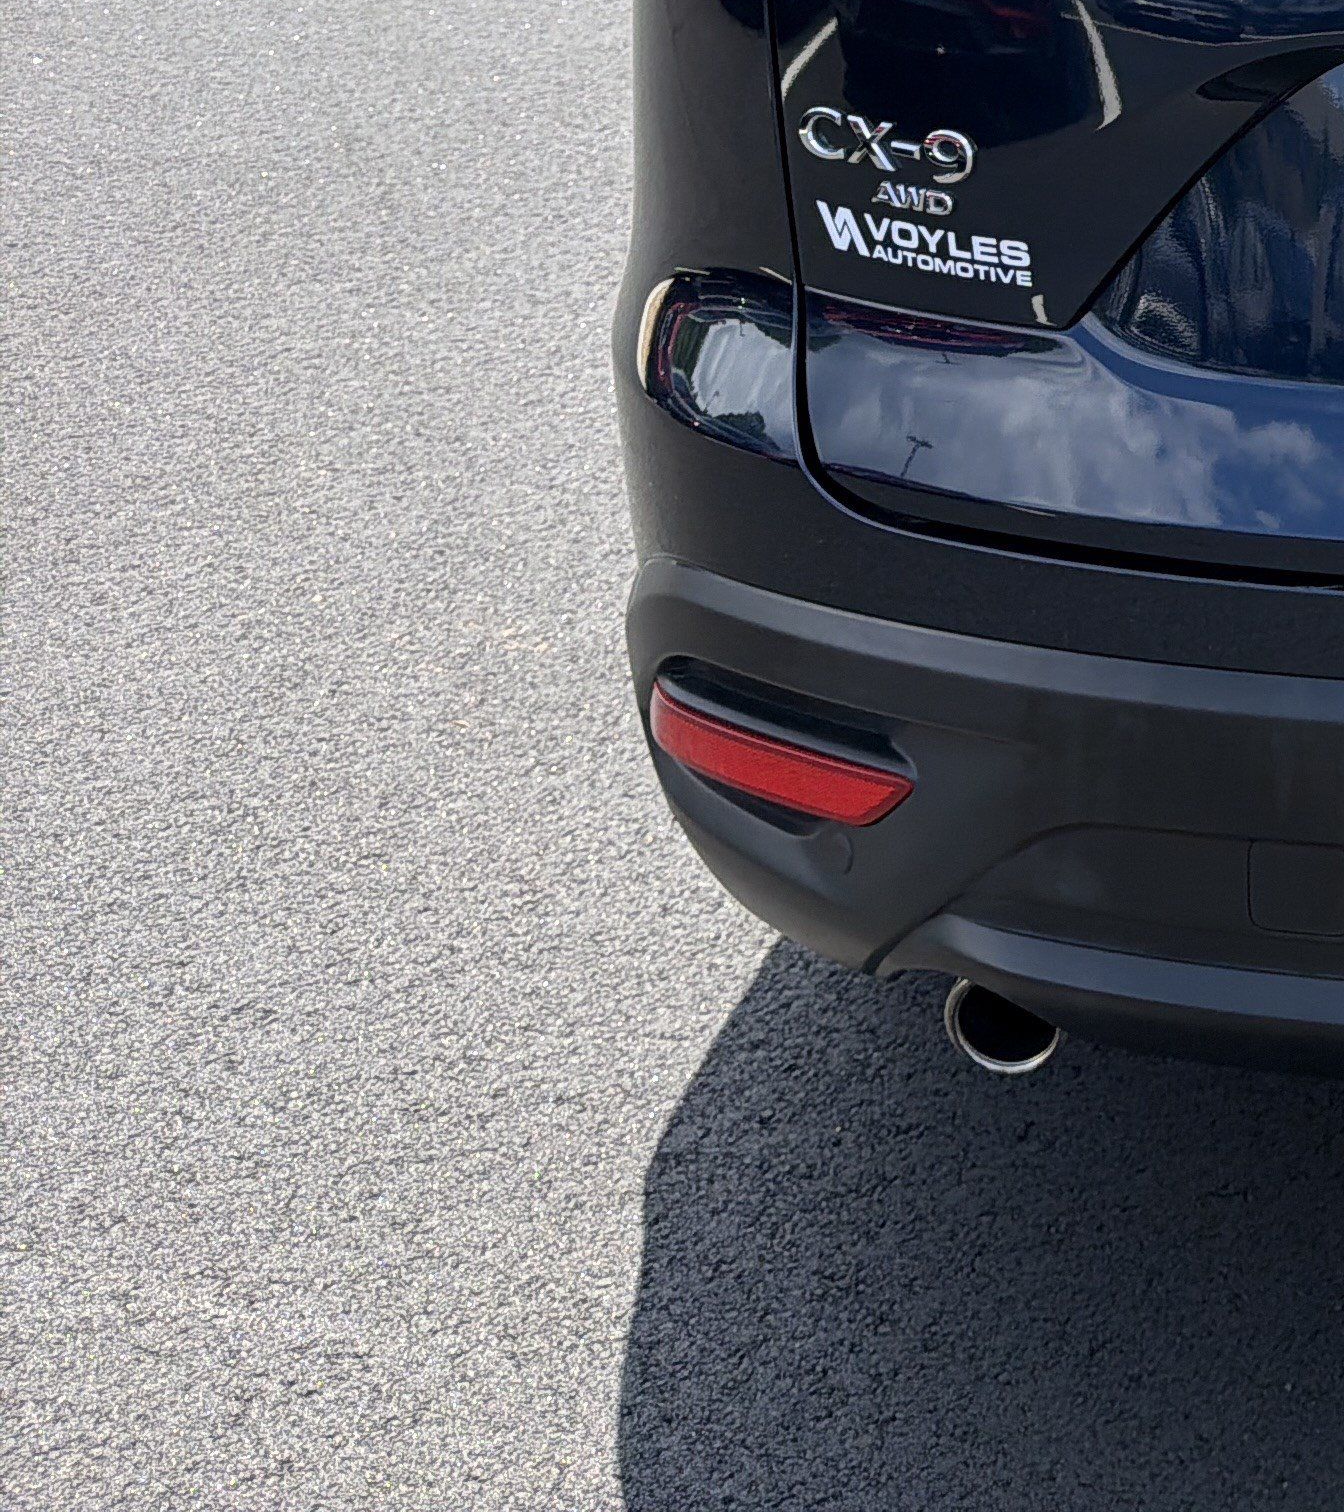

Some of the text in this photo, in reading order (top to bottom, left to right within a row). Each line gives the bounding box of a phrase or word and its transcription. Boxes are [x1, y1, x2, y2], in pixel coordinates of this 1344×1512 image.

[799, 106, 976, 184] CX-9
[871, 180, 953, 215] AWD
[863, 213, 1031, 267] VOYLES
[872, 244, 1033, 287] AUTOMOTIVE
